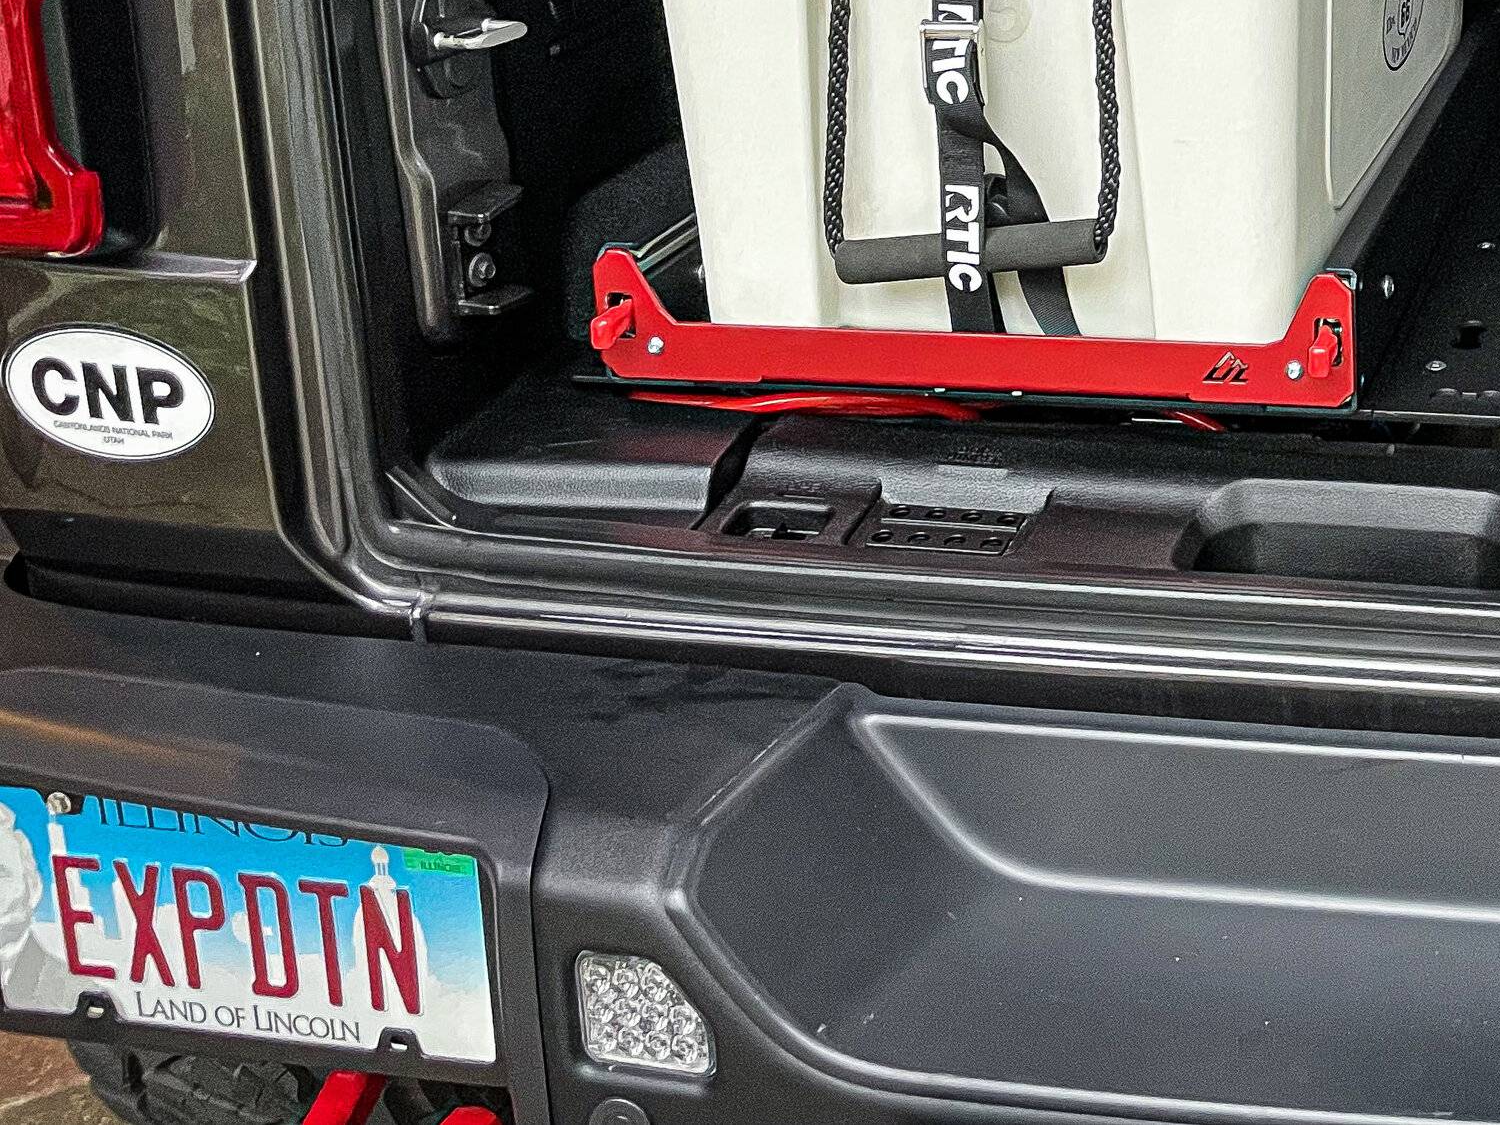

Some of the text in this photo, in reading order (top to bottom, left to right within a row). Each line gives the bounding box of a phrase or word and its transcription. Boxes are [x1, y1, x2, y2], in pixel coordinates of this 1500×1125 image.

[944, 183, 983, 293] RTIC
[31, 356, 185, 426] CNP
[51, 854, 422, 1016] EXPDTN
[135, 990, 361, 1043] LAND OF LINCOLN
